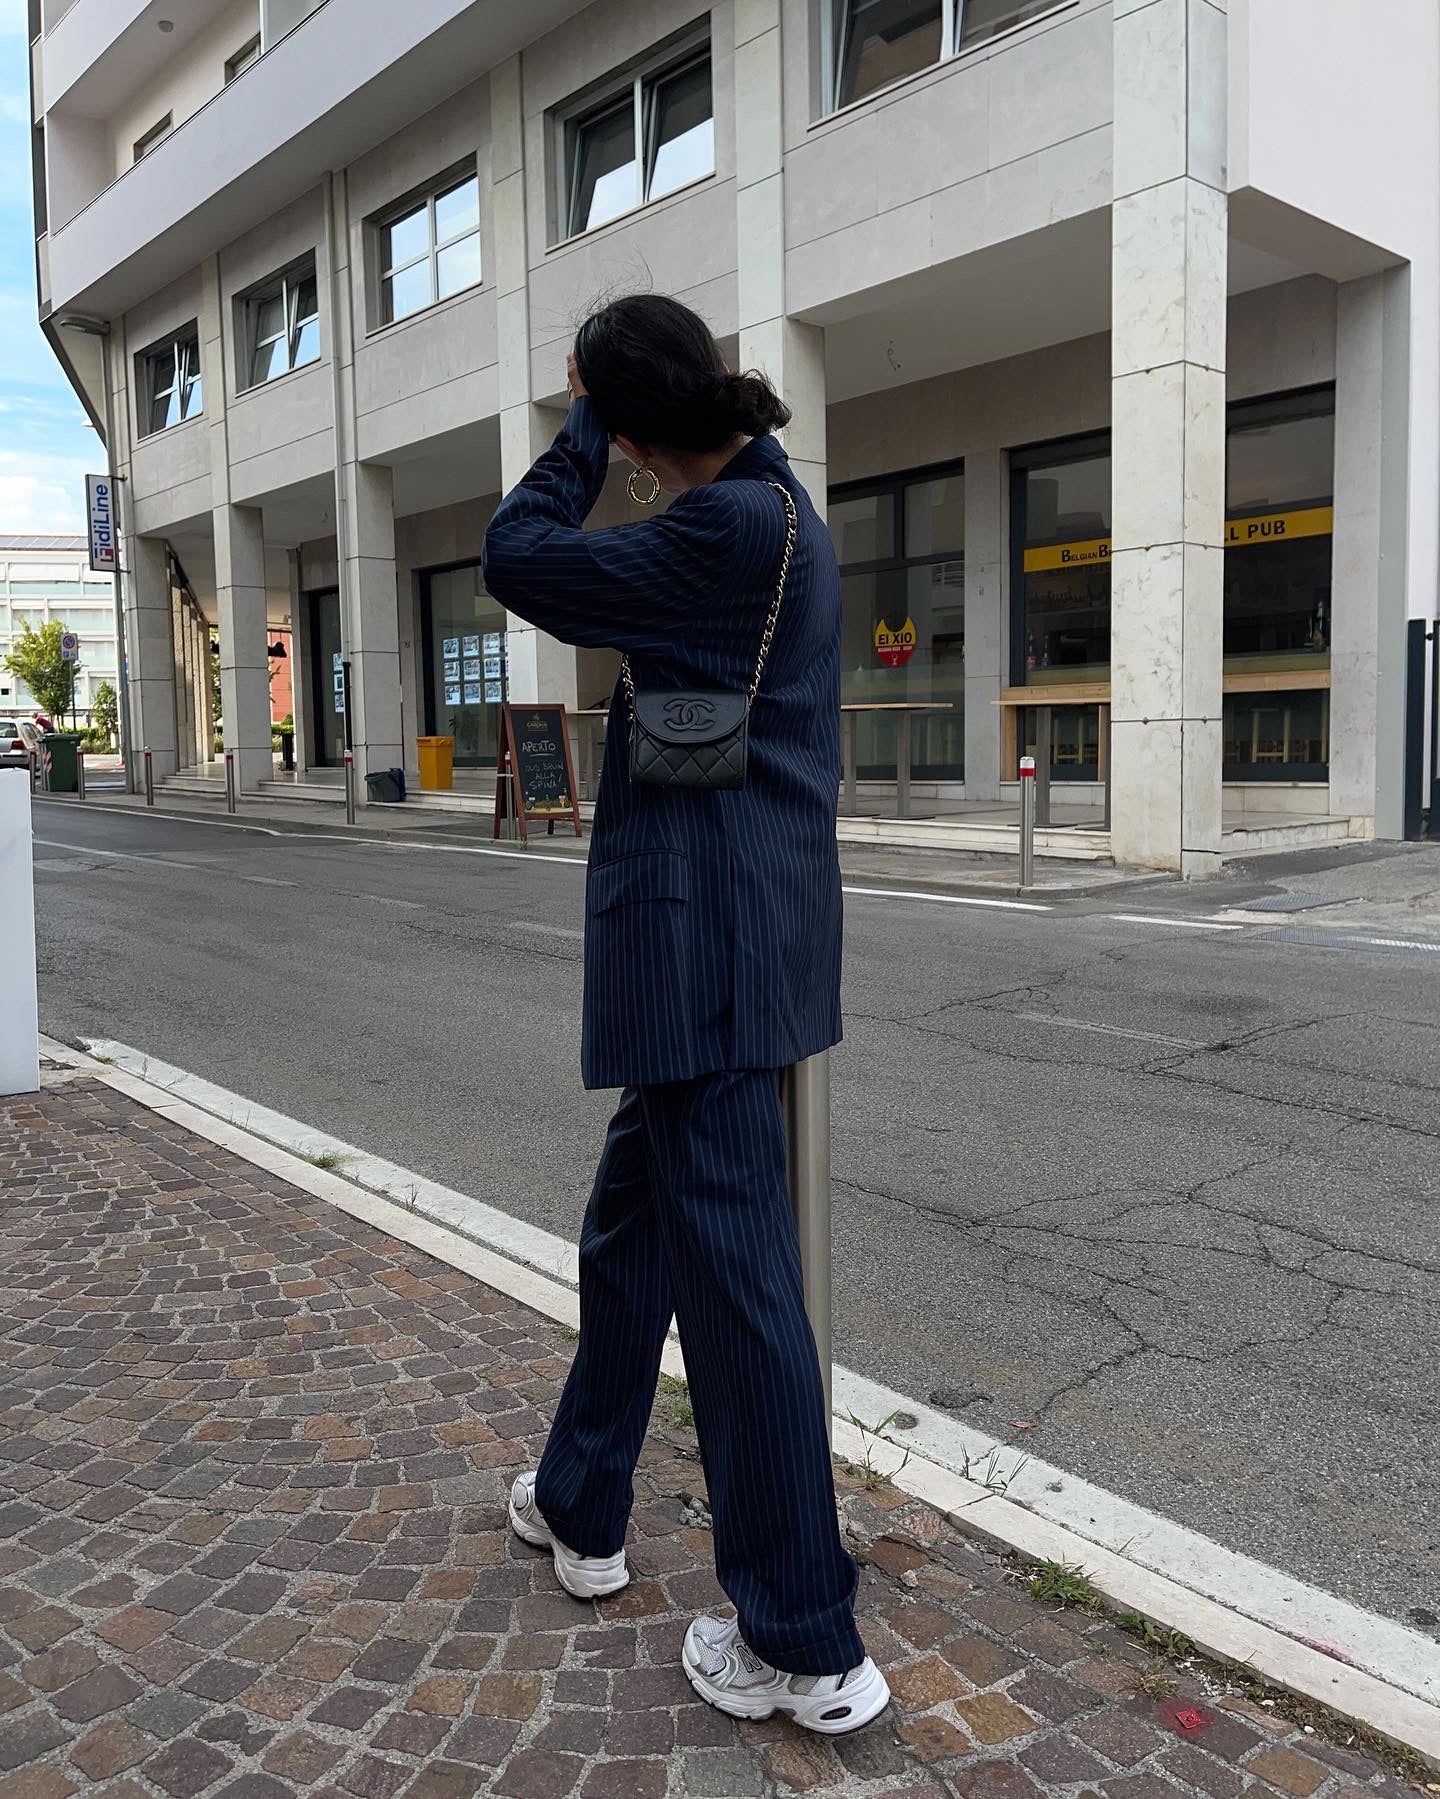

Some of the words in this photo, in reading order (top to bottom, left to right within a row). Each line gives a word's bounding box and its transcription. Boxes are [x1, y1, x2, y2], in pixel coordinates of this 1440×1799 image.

[1248, 519, 1286, 538] PUB
[893, 632, 912, 644] XIO
[522, 740, 556, 752] APERTO
